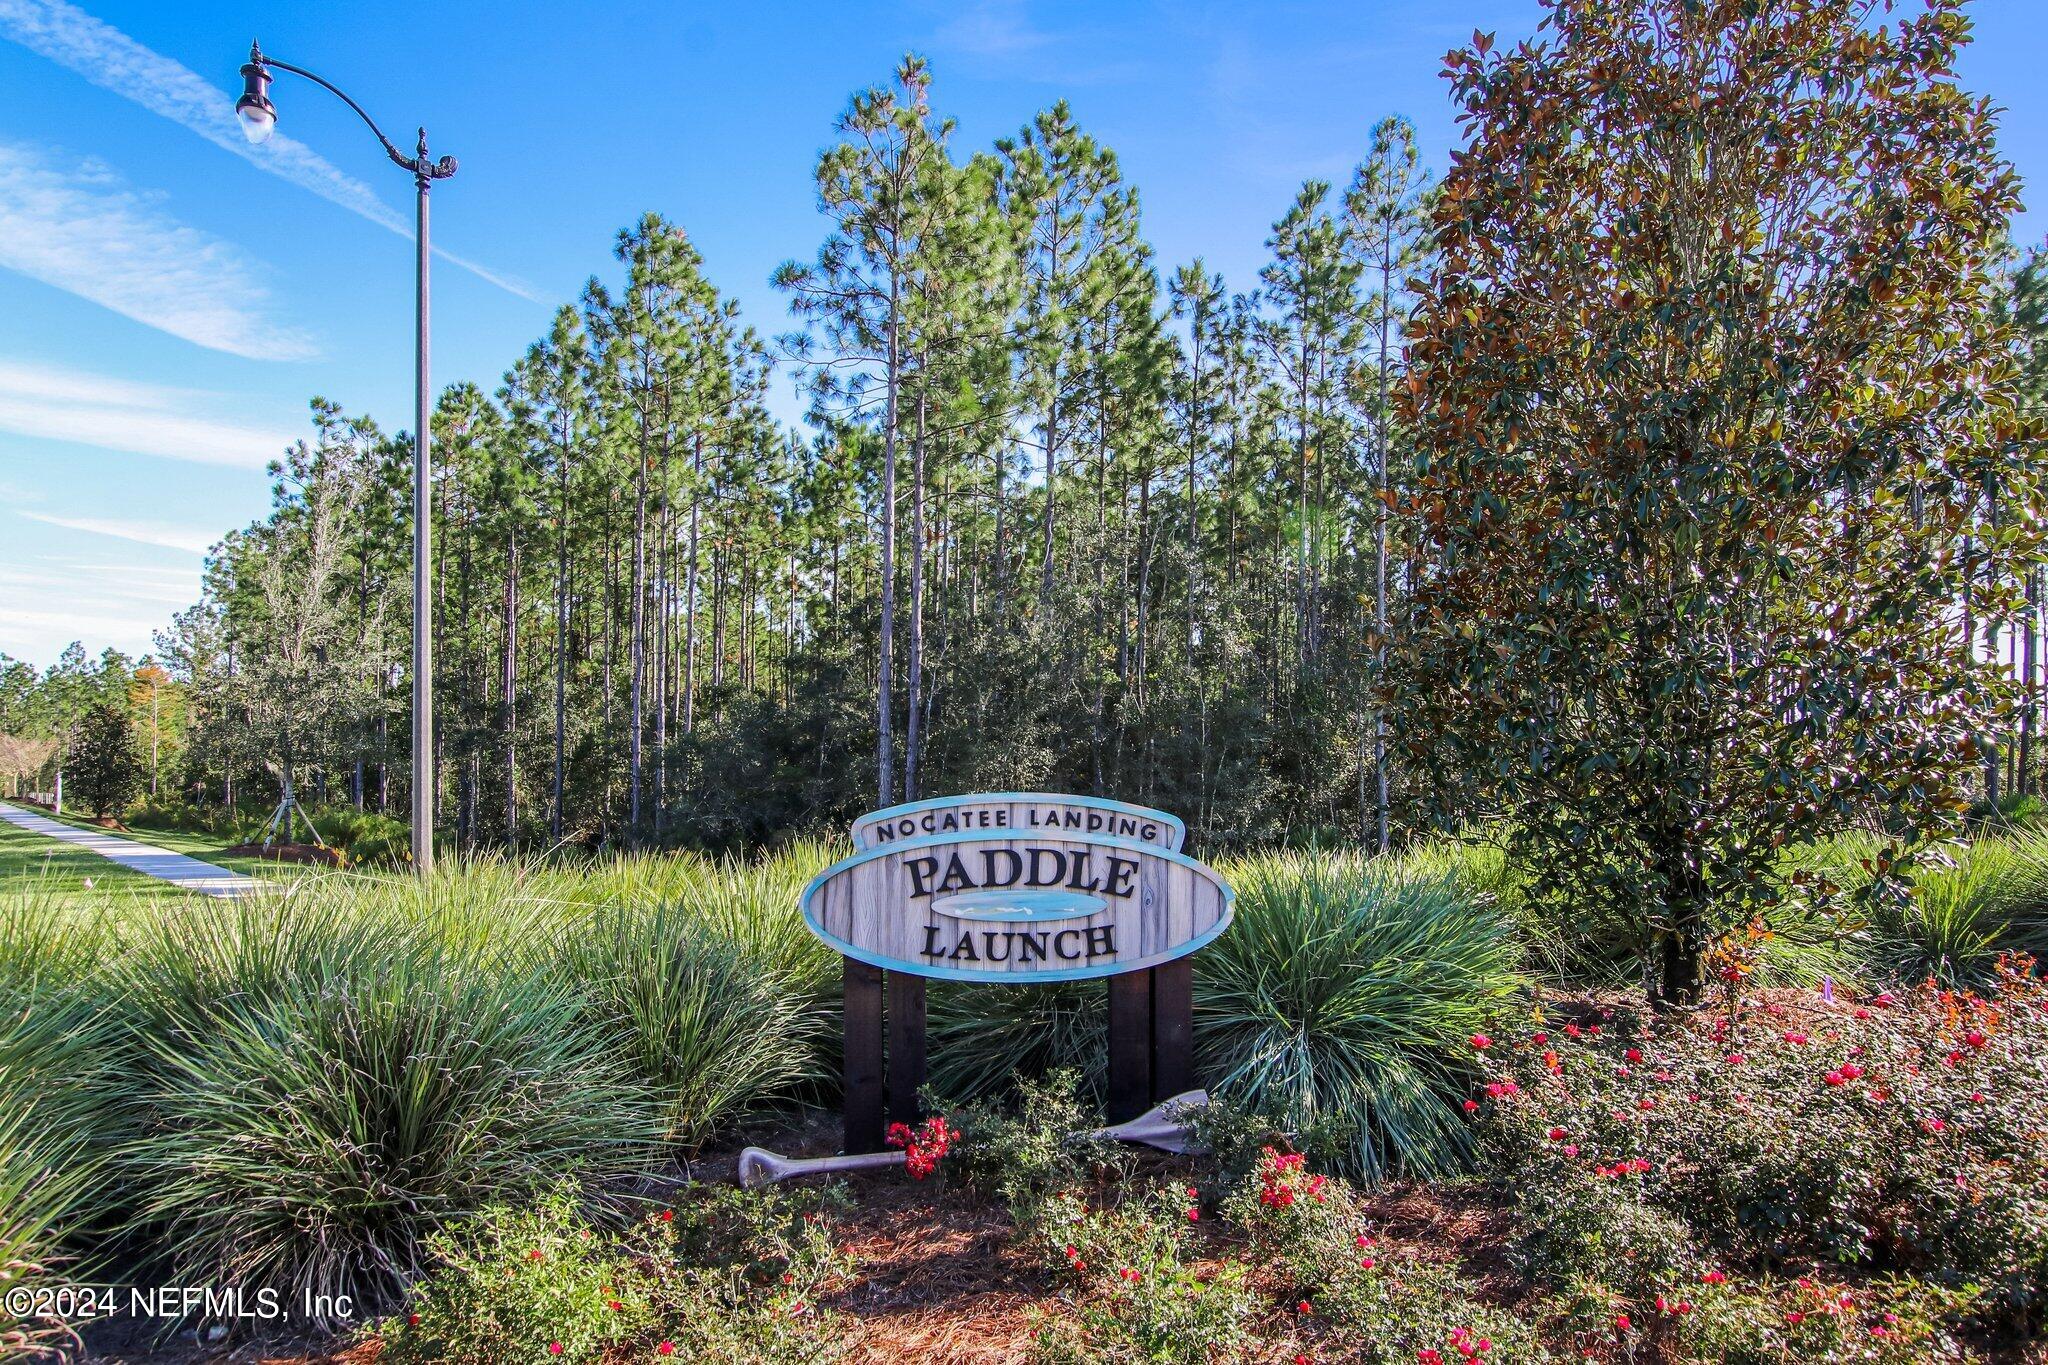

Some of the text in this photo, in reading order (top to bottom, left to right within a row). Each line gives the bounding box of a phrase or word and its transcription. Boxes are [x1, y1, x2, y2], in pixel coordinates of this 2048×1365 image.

[877, 810, 1158, 842] NOCATEE LANDING
[903, 848, 1140, 899] PADDLE
[920, 924, 1119, 962] LAUNCH
